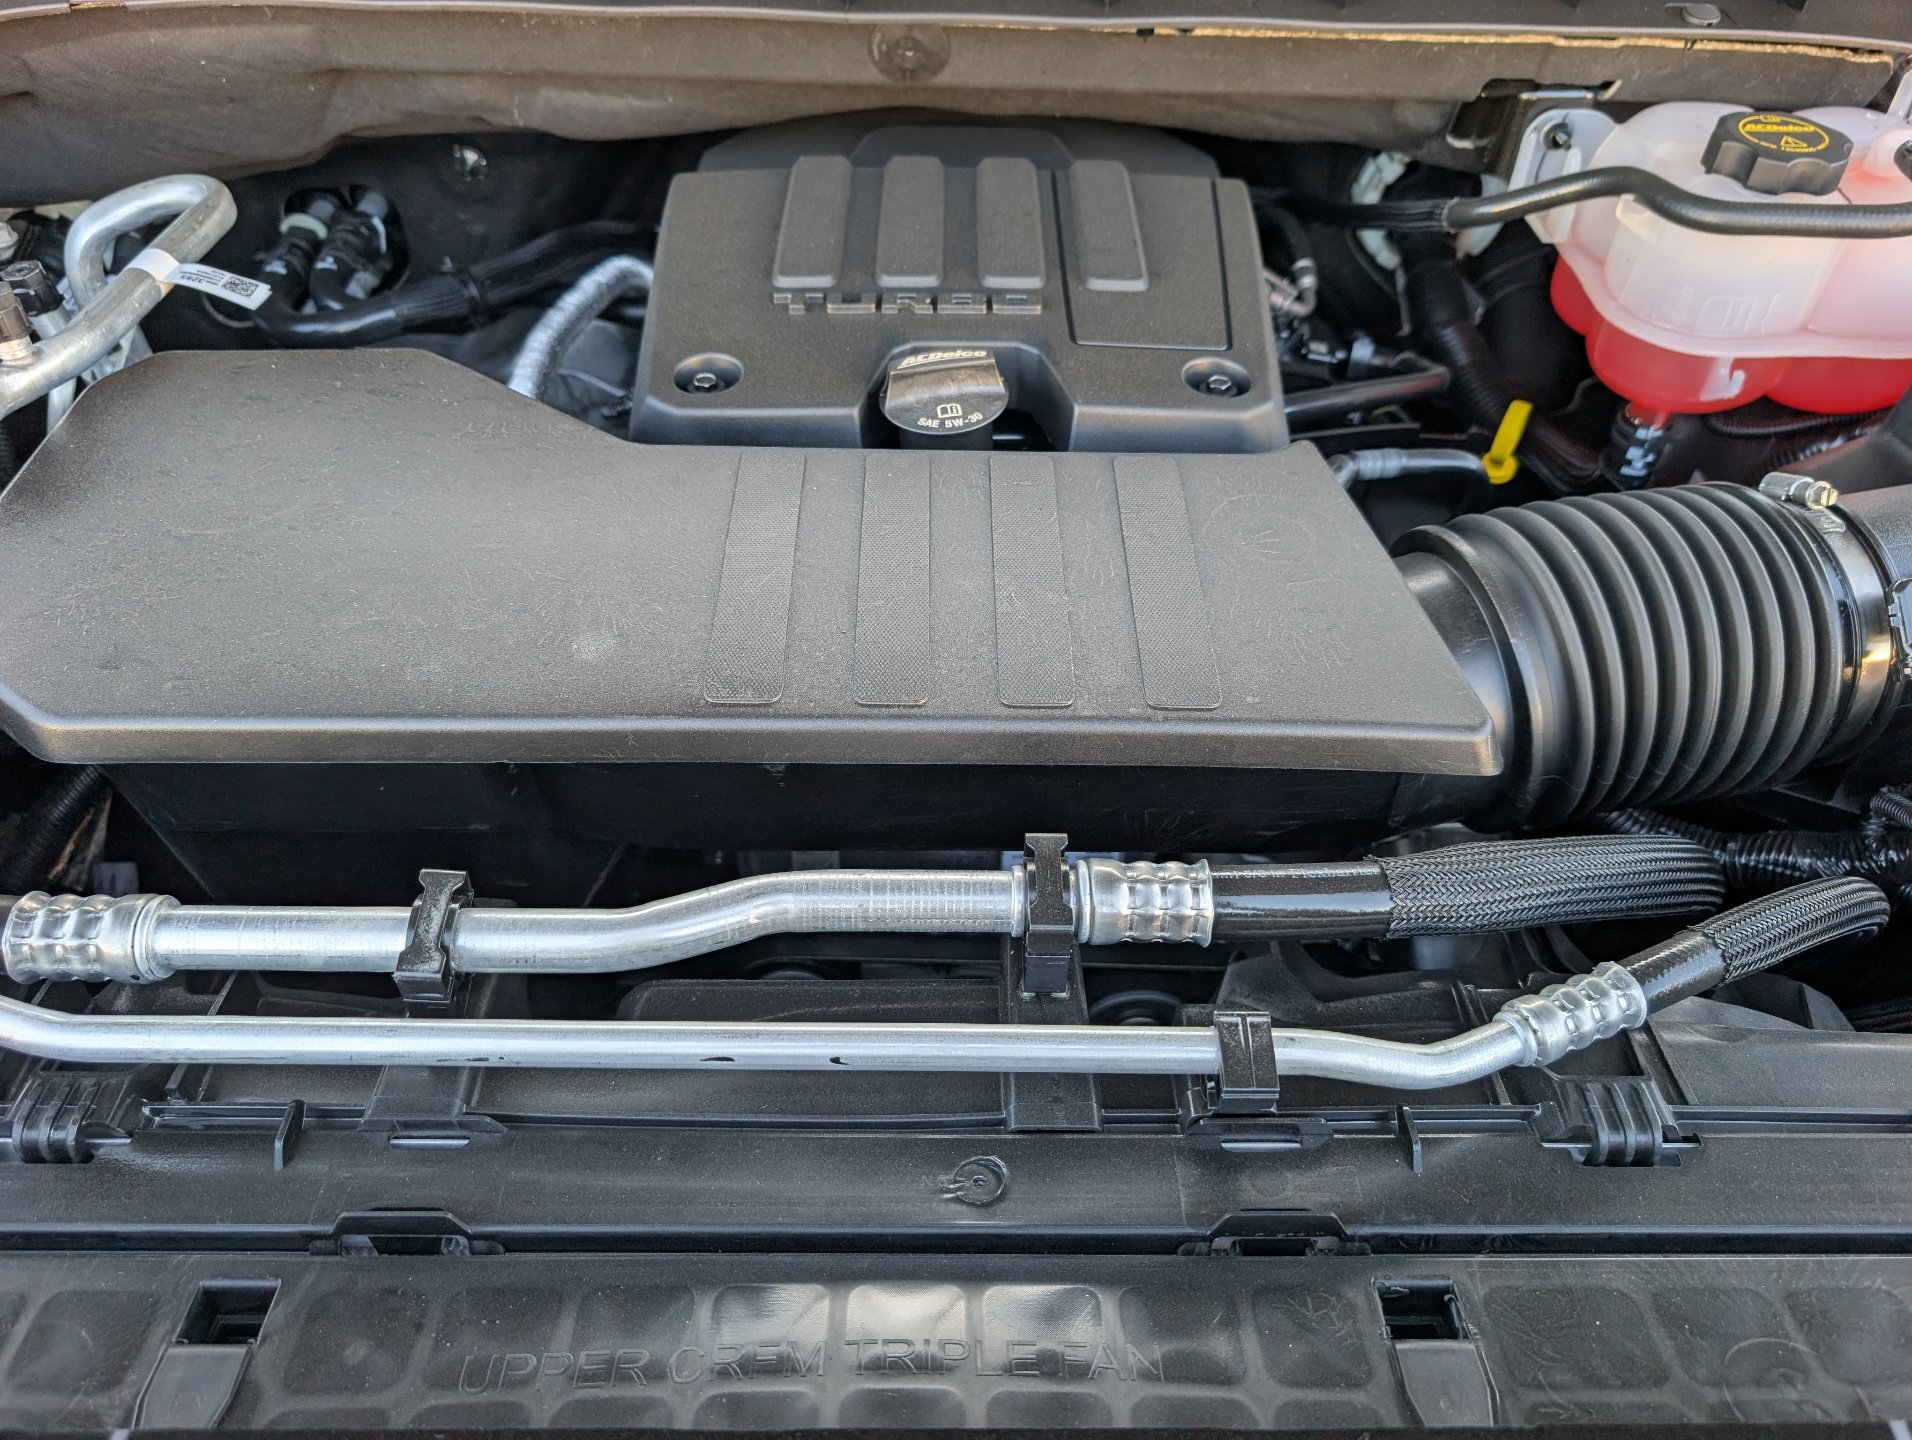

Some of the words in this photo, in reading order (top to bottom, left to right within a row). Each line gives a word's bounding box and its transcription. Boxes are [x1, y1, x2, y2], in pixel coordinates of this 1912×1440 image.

[773, 292, 1042, 314] TURBO
[898, 350, 987, 369] ACDelco
[917, 416, 941, 428] SAE
[945, 412, 983, 428] 5W-30
[458, 1348, 650, 1394] UPPER
[843, 1338, 1039, 1377] TRIPLE
[1059, 1341, 1164, 1382] FAN
